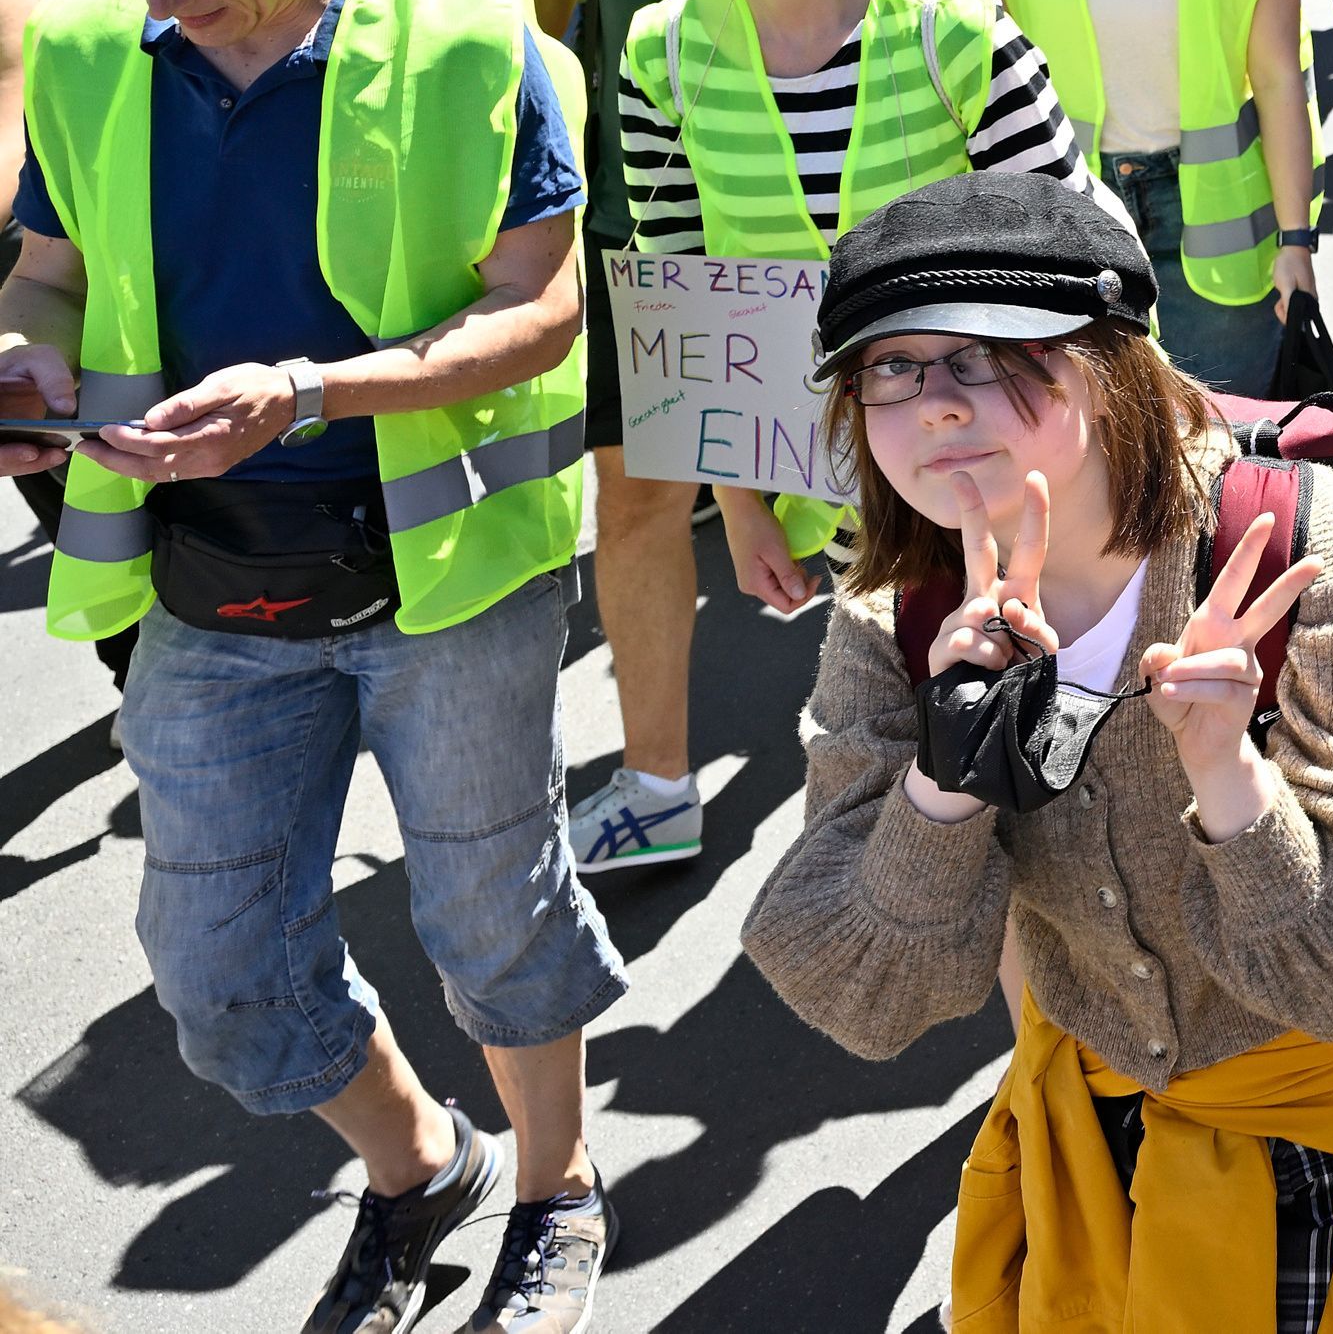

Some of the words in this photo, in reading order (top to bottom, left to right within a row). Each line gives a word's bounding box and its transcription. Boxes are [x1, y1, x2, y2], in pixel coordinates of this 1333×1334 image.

[333, 176, 386, 190] UTHENTIC
[610, 257, 690, 291] MER
[631, 326, 763, 384] MER
